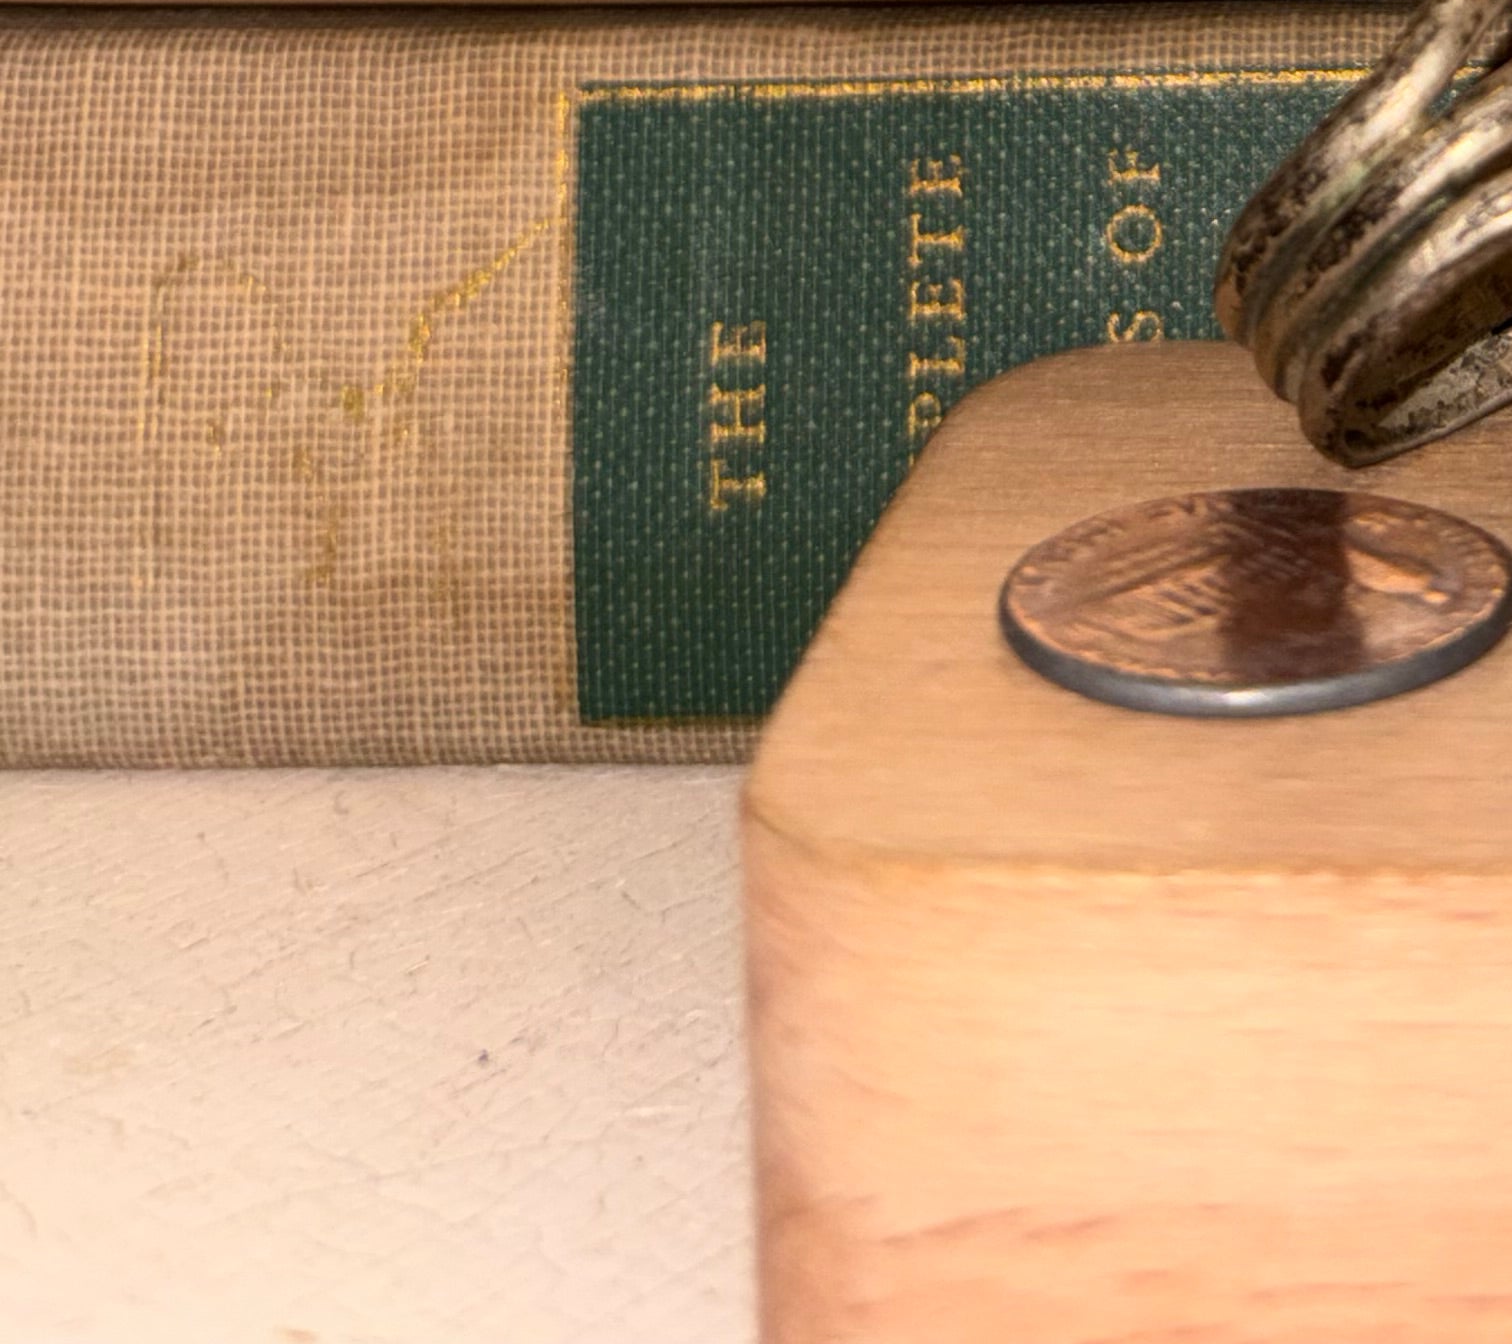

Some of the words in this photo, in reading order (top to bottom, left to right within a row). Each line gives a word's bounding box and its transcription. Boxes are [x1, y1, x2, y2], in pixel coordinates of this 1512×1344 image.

[1105, 148, 1163, 264] OF
[907, 154, 967, 465] PLETE
[709, 319, 767, 511] THE
